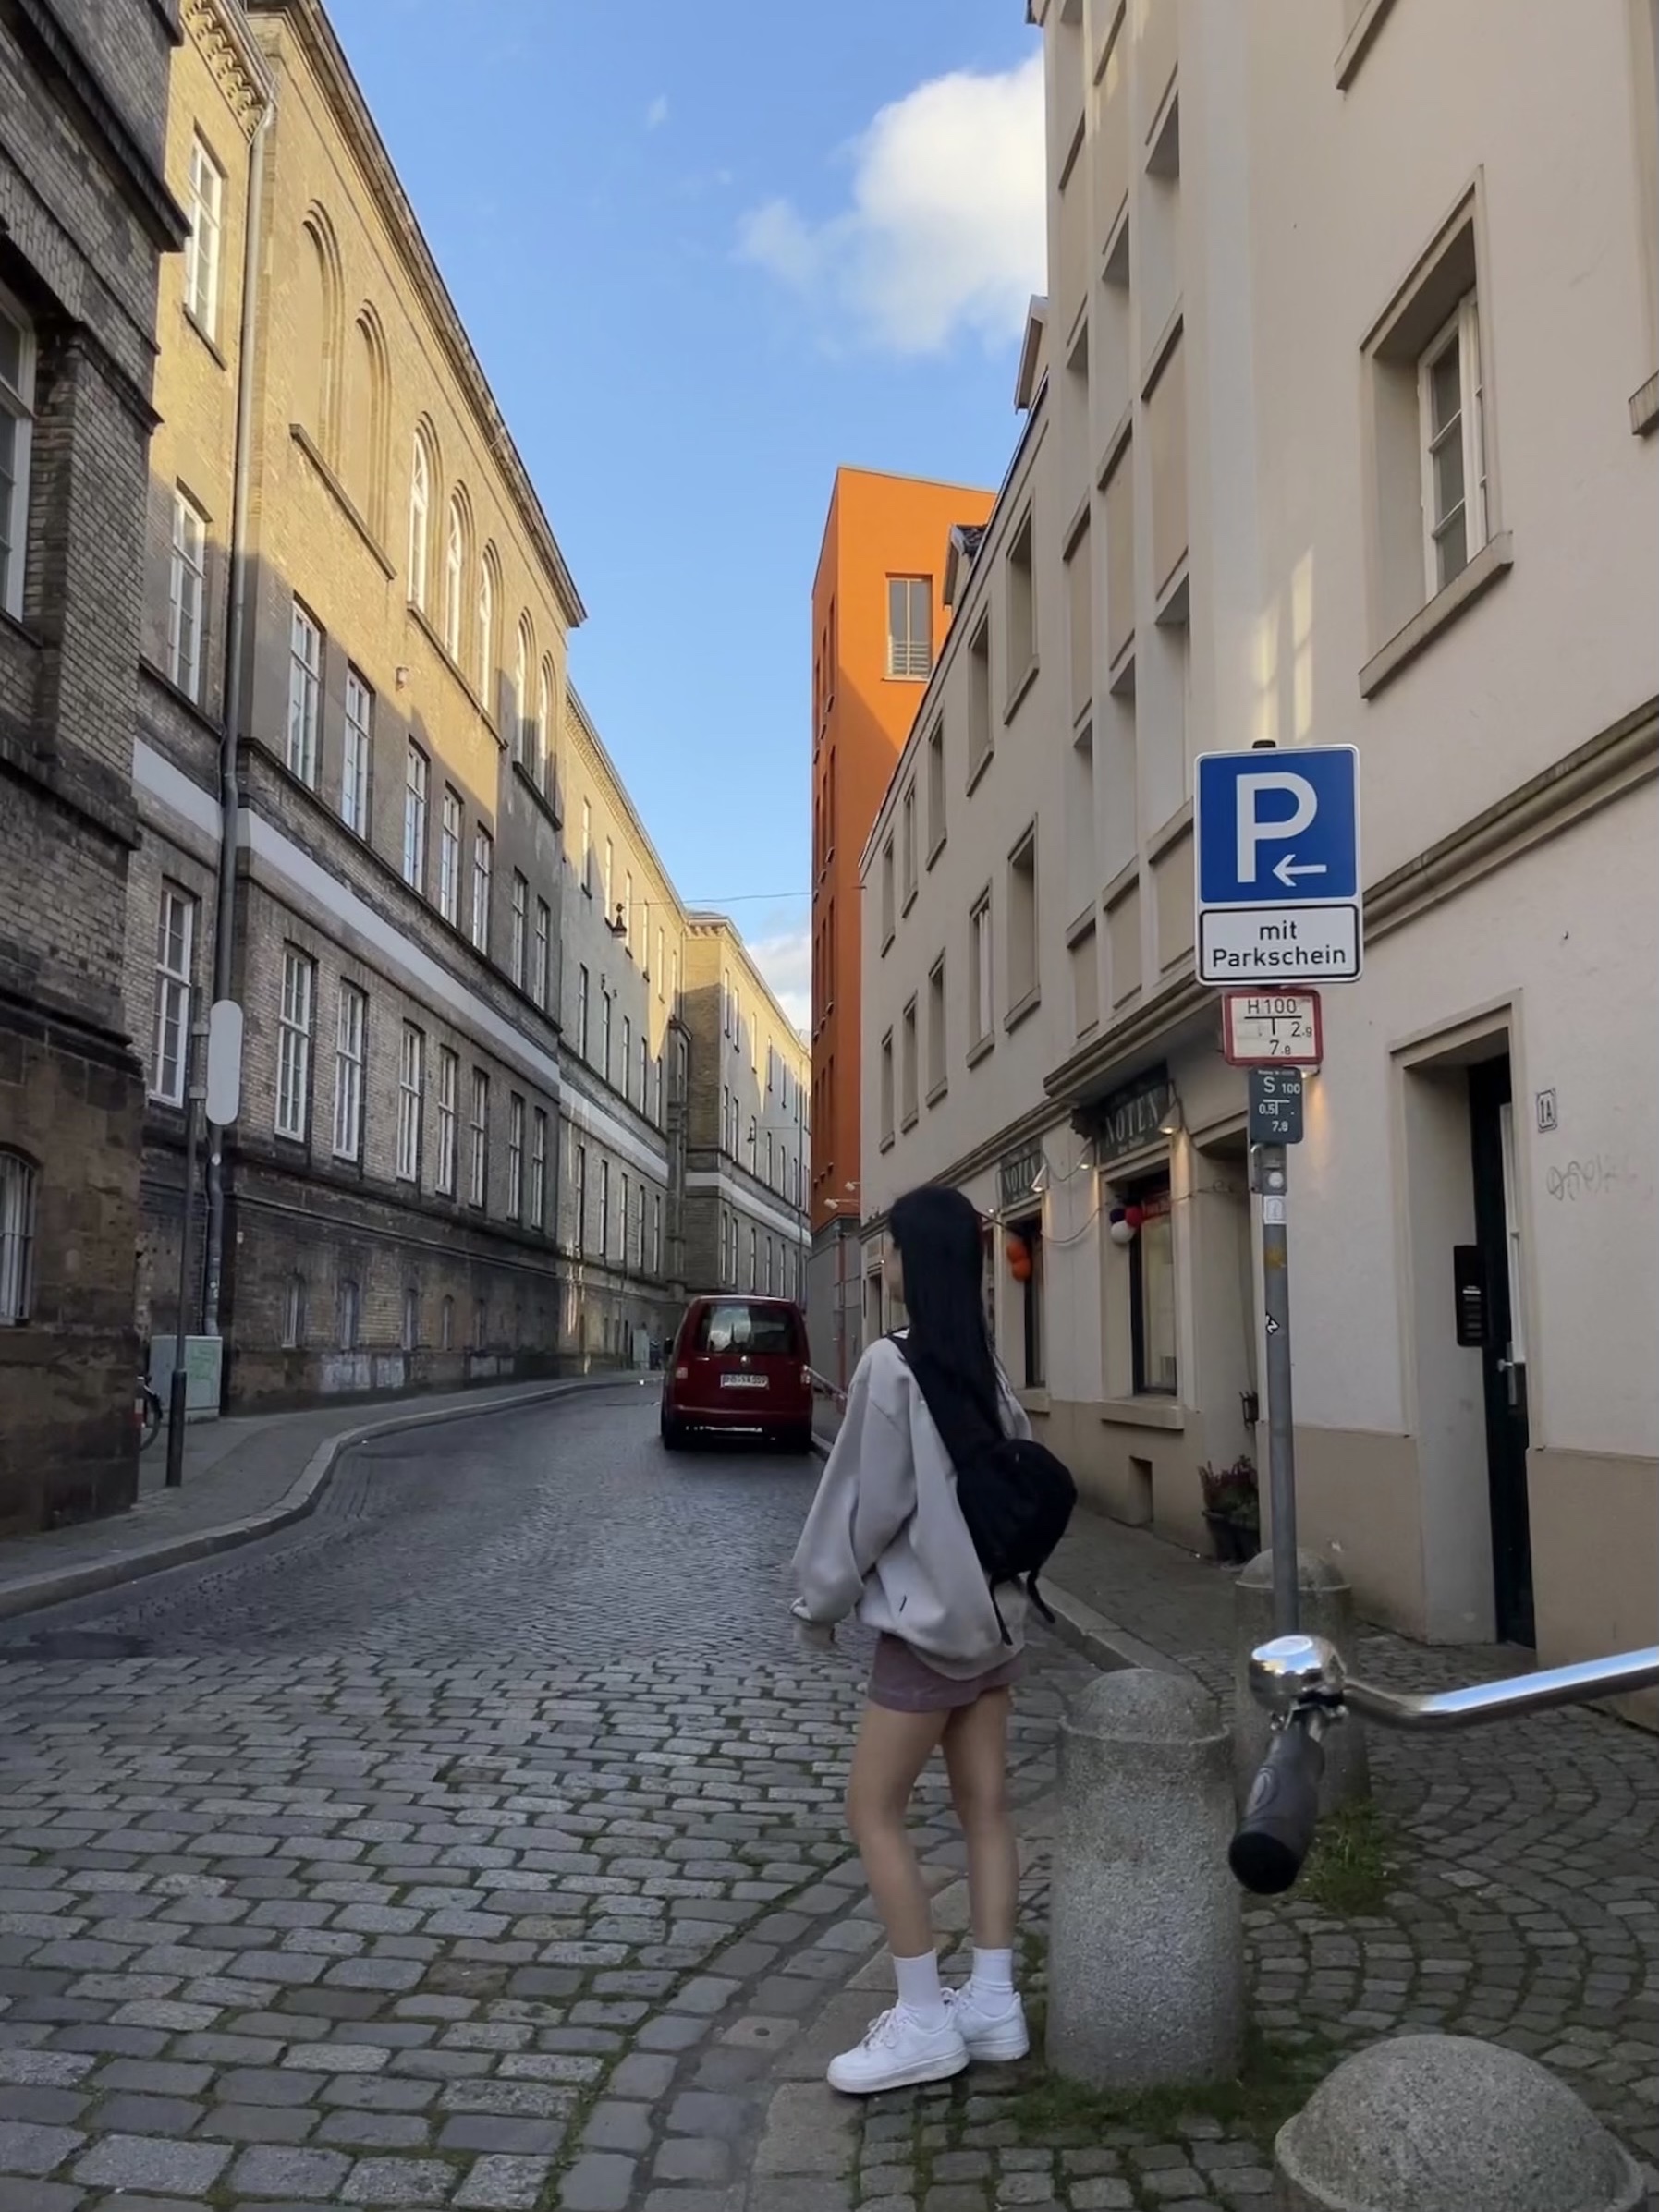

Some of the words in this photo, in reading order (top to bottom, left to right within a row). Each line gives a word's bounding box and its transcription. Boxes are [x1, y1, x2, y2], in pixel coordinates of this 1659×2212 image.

[1236, 771, 1318, 883] P
[1259, 920, 1298, 941] mit
[1213, 945, 1347, 968] Parkschein
[1269, 1039, 1291, 1056] 7.8
[1281, 1083, 1301, 1095] 100
[1272, 1120, 1289, 1133] 7.8
